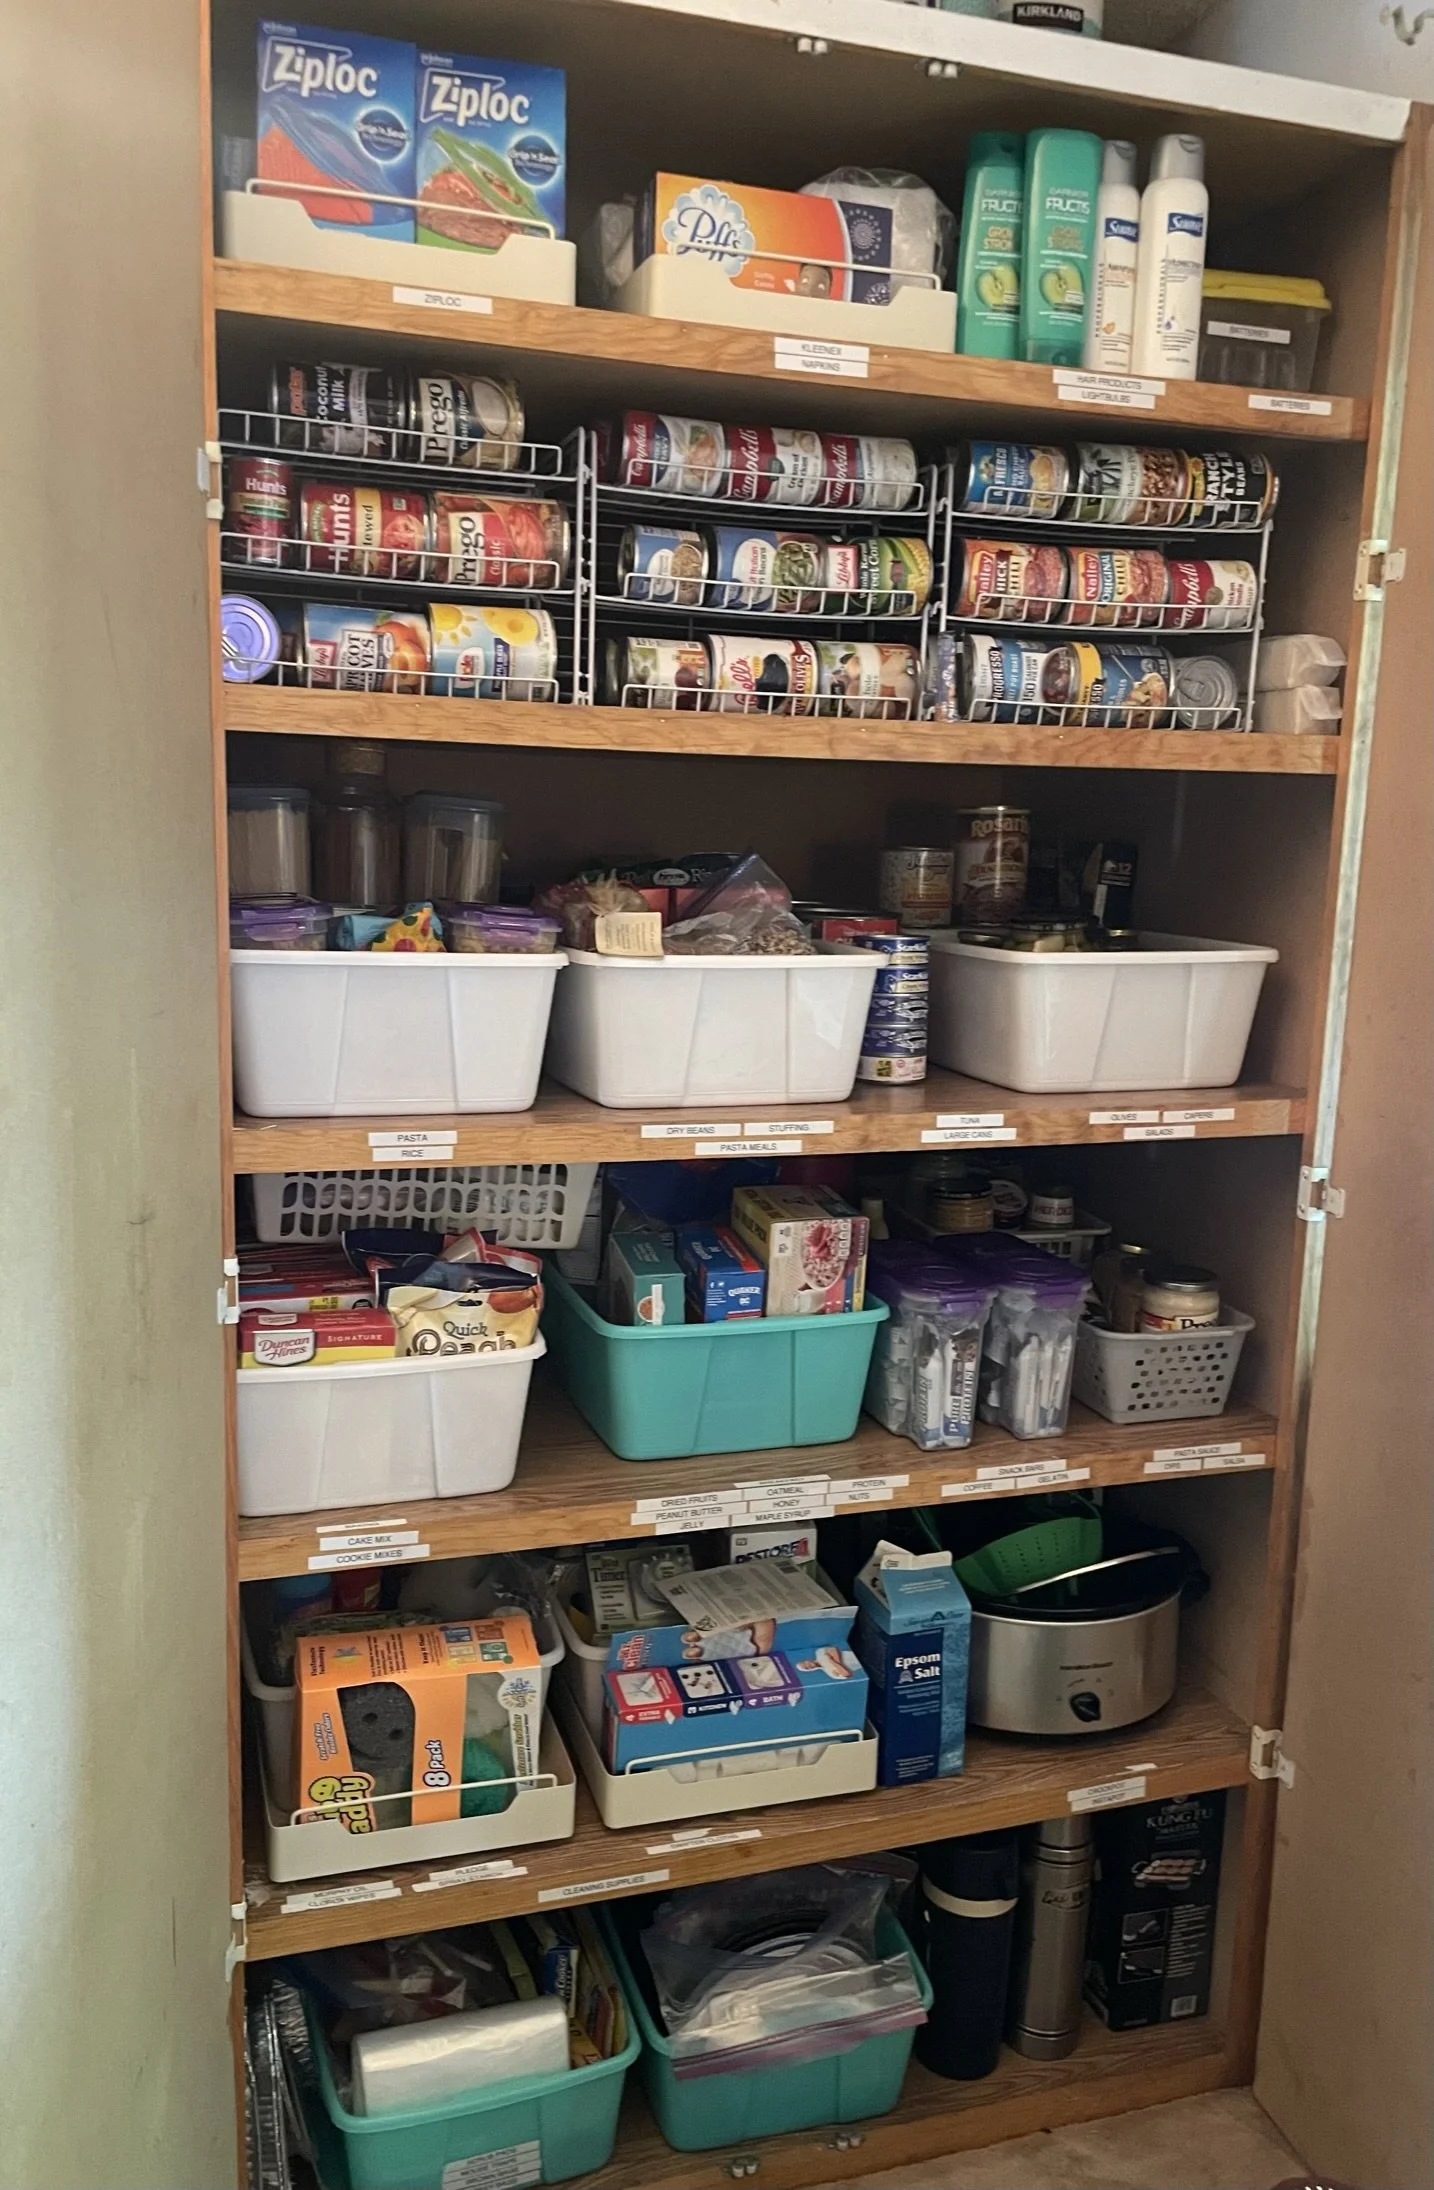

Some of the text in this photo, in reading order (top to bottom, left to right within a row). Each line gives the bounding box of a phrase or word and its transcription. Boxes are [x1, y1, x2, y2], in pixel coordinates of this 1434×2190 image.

[1017, 5, 1082, 22] KIRKLAND
[273, 45, 378, 98] Ziploc
[430, 75, 530, 127] Ziploc
[1045, 196, 1090, 214] FRUCTIS
[424, 293, 462, 308] ZIPLOC
[801, 342, 842, 357] KLEENEX
[801, 359, 841, 372] NAPKINS
[1099, 377, 1142, 391] PRODUCTS
[333, 379, 345, 412] Milk
[1081, 390, 1131, 404] LIGHTBULBS
[427, 383, 452, 453] Prego
[1234, 461, 1246, 497] BEANS
[455, 516, 484, 583] Prego
[996, 559, 1008, 593] HICK
[1086, 555, 1099, 599] Nalley
[1116, 562, 1126, 597] CHILI
[794, 654, 810, 692] OLIVES
[1022, 682, 1036, 702] 150
[767, 1122, 811, 1134] STUFFING
[959, 1115, 981, 1126] TUNA
[397, 1132, 430, 1144] PASTA
[666, 1125, 716, 1136] DRY BEANS
[943, 1128, 994, 1141] LARGE CANS
[401, 1147, 425, 1160] RICE
[720, 1140, 779, 1153] PASTA MEALS
[326, 1332, 383, 1343] SIGNATURE
[442, 1320, 488, 1340] Quick
[258, 1335, 311, 1354] Duncan
[268, 1345, 307, 1362] Hines
[998, 1463, 1045, 1476] SNACK BARS
[851, 1478, 887, 1489] PROTEIN
[1037, 1472, 1069, 1484] GELATIN
[766, 1486, 805, 1497] OATMEAL
[963, 1481, 993, 1492] COFFEE
[660, 1494, 718, 1508] DRIED FRUITS
[772, 1498, 800, 1509] HONEY
[848, 1492, 870, 1501] NUTS
[655, 1506, 723, 1521] PEANUT BUTTER
[755, 1509, 811, 1522] MAPLE SYRUP
[679, 1520, 705, 1531] JELLY
[347, 1535, 393, 1547] CAKE MIX
[335, 1549, 403, 1564] COOKIE MIXES
[894, 1652, 942, 1669] Epsom
[913, 1664, 942, 1680] Salt
[762, 1694, 784, 1703] BATH
[422, 1739, 452, 1788] 8 Pack
[562, 1874, 646, 1897] CLEANING SUPPLIES
